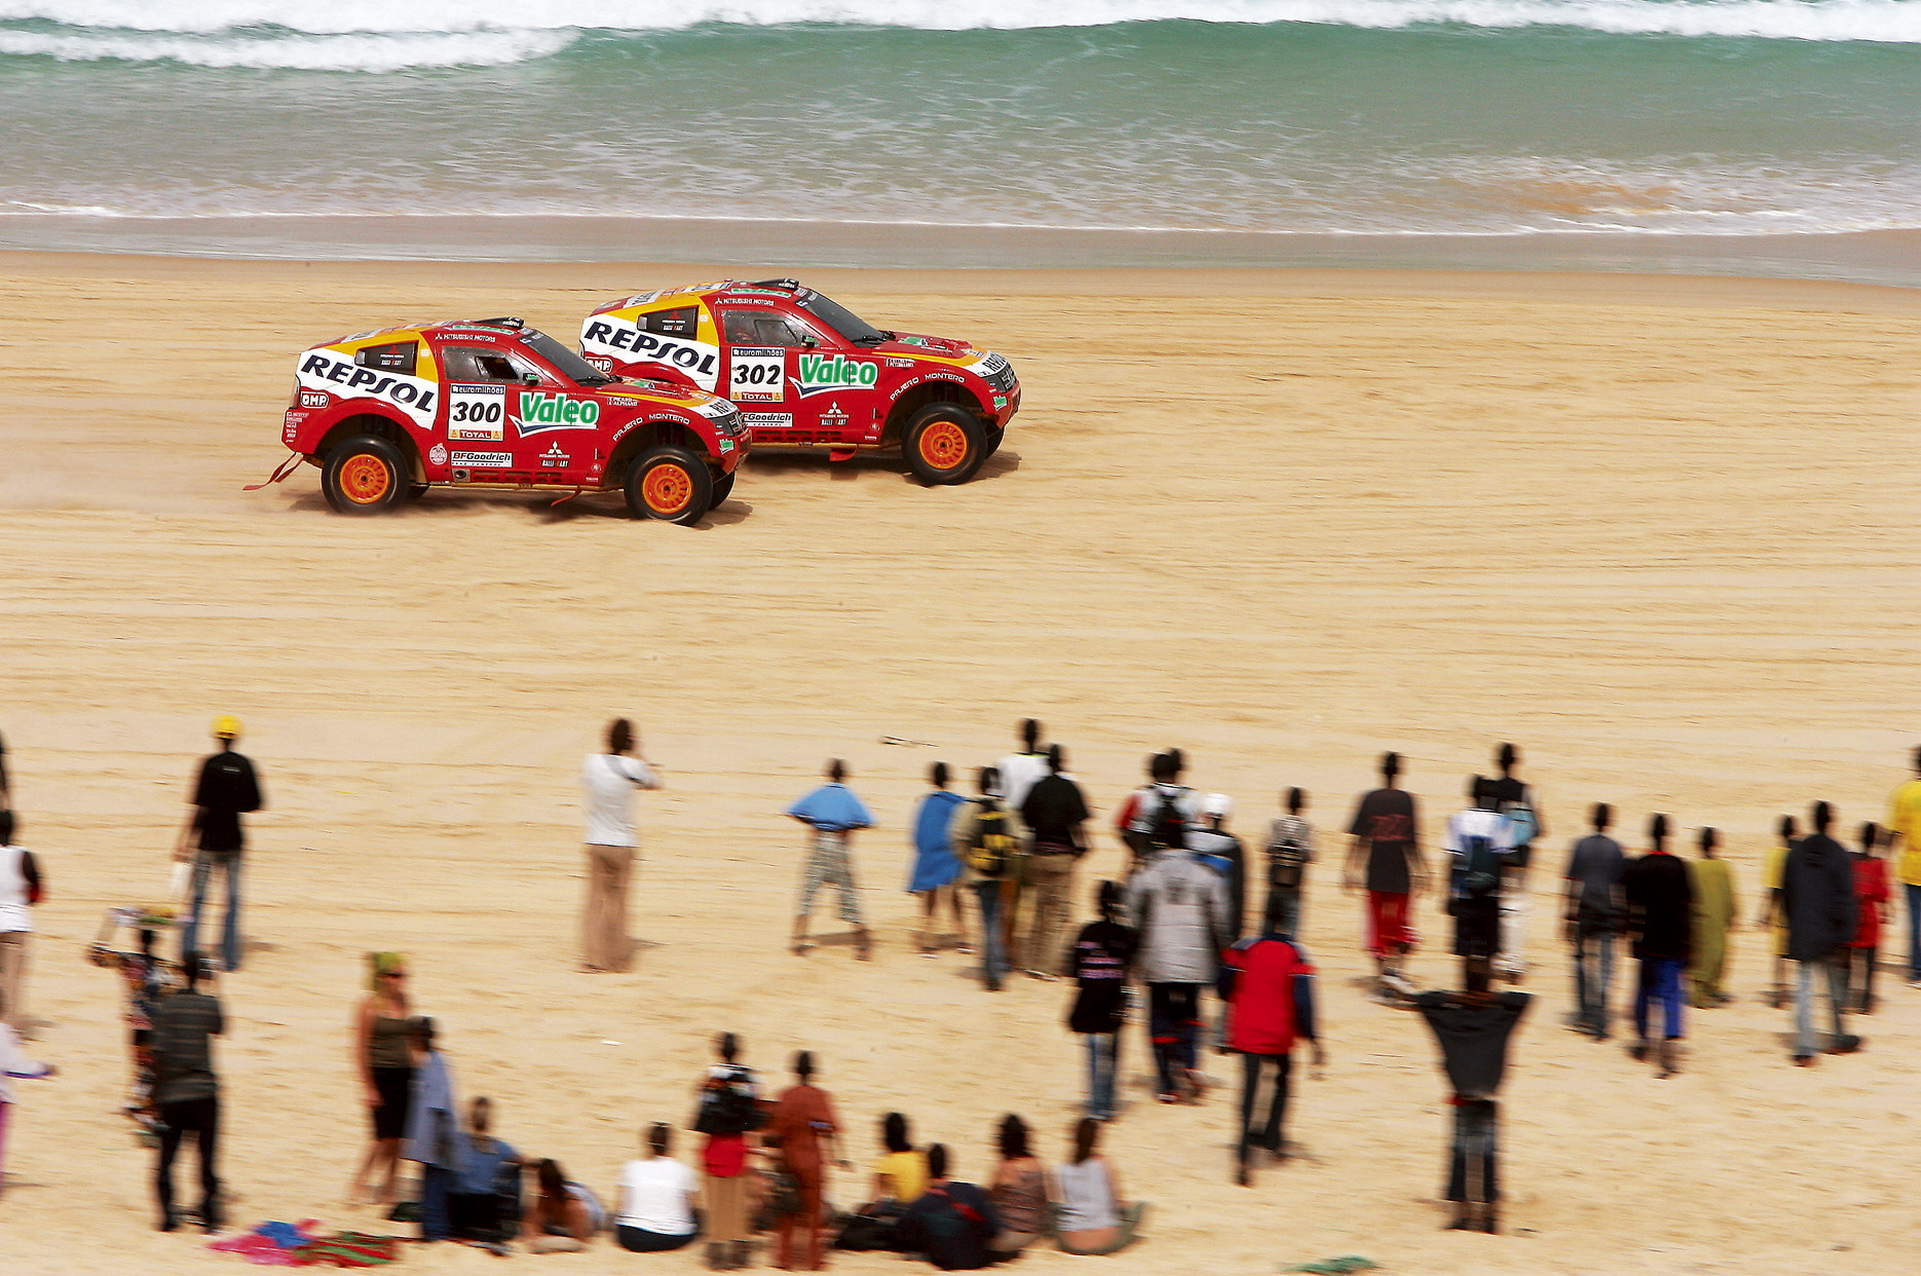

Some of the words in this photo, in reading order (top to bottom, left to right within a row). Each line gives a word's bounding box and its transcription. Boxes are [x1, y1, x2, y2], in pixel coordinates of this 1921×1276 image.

[584, 321, 716, 376] REPSOL
[734, 364, 782, 385] 302
[799, 355, 879, 386] Valeo
[924, 372, 966, 383] MONTERO
[300, 354, 435, 413] REPSOL
[890, 376, 920, 401] PAJERO
[742, 392, 772, 400] TOTAL
[453, 401, 501, 423] 300
[520, 393, 599, 425] Valeo
[648, 413, 690, 425] MONTERO
[743, 413, 791, 421] FGoodrich
[612, 416, 644, 441] PAJERO
[453, 452, 511, 461] BFGoodrich
